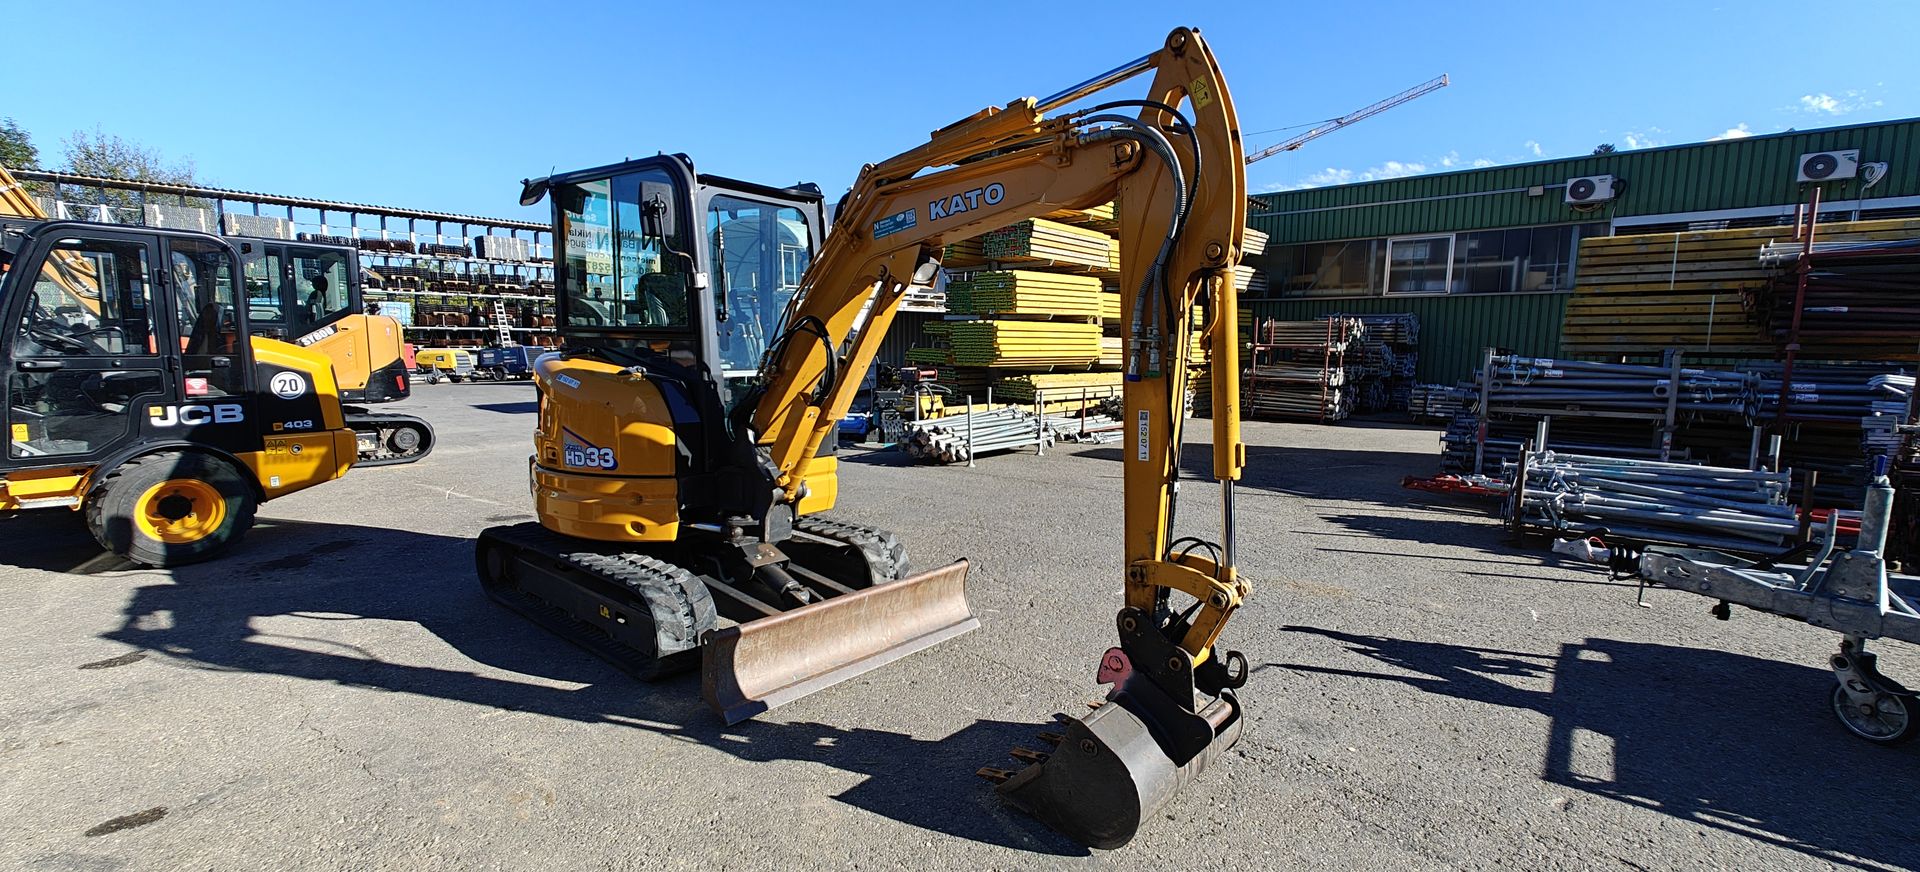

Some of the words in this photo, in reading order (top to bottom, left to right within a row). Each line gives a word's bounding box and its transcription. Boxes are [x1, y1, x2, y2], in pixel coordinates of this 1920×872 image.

[928, 183, 1006, 221] KATO
[299, 326, 335, 346] SY80U
[278, 379, 298, 392] 20
[149, 404, 244, 427] JCB
[283, 419, 313, 428] 403
